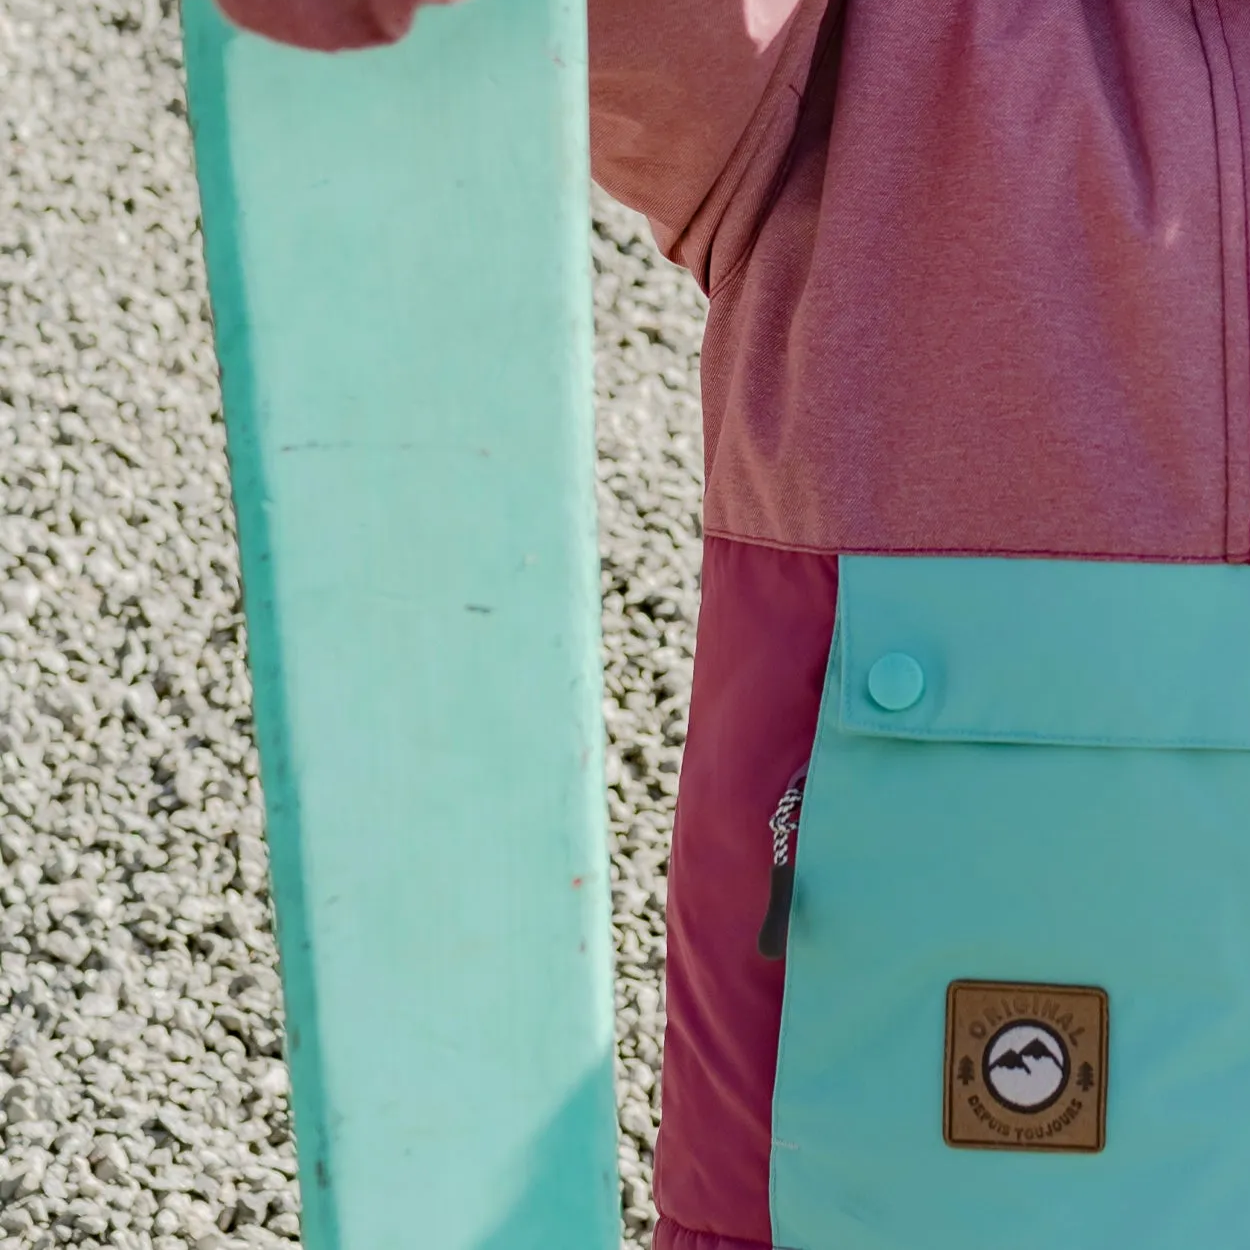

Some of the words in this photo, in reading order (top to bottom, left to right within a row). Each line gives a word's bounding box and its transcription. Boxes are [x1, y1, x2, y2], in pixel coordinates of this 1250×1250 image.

[969, 993, 1085, 1047] ORIGINAL
[967, 1094, 1010, 1136] DEPUIS
[1014, 1097, 1083, 1140] TOUJOURS
